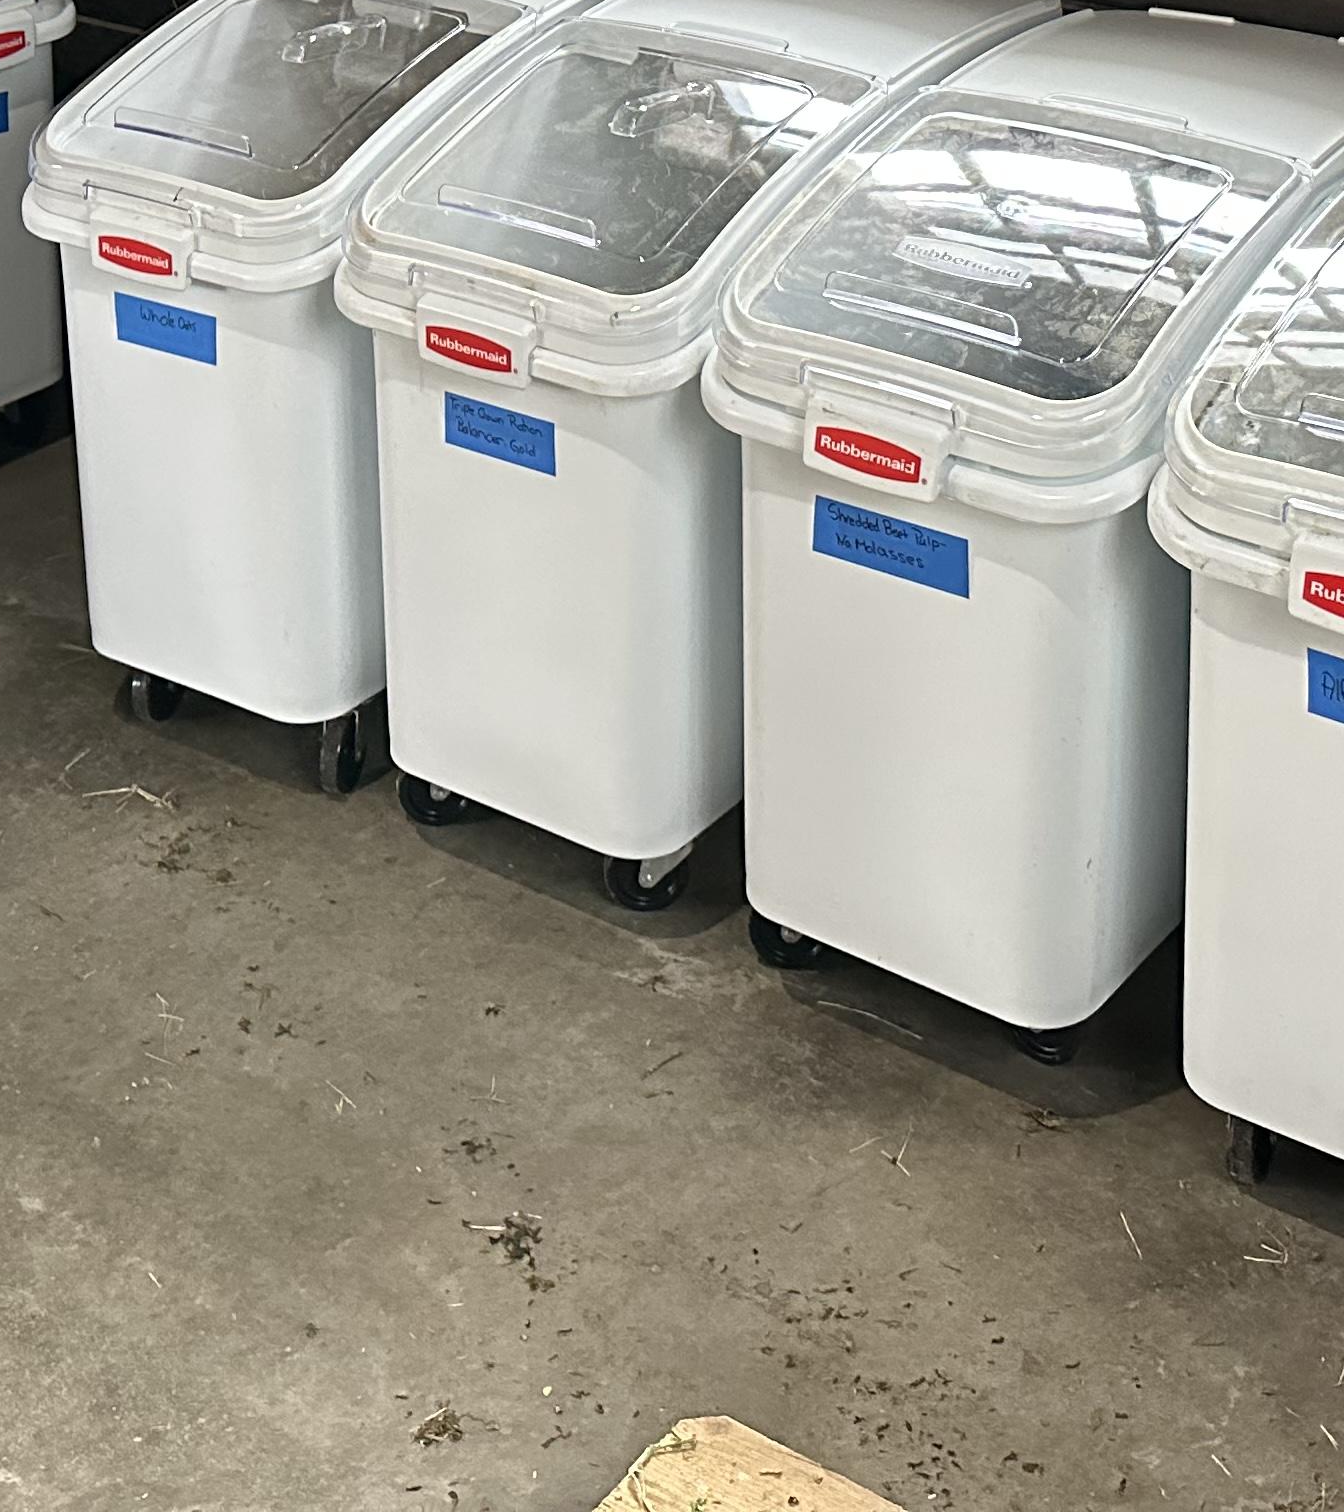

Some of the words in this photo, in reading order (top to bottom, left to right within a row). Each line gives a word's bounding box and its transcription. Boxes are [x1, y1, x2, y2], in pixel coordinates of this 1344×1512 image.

[102, 242, 169, 269] Rubbermaid
[905, 243, 1021, 279] Rubbermaid
[140, 304, 175, 328] Whole
[430, 333, 507, 365] Rubbermaid
[820, 435, 916, 475] Rubbermaid
[827, 503, 880, 532] Shredded
[856, 538, 925, 569] Molasses
